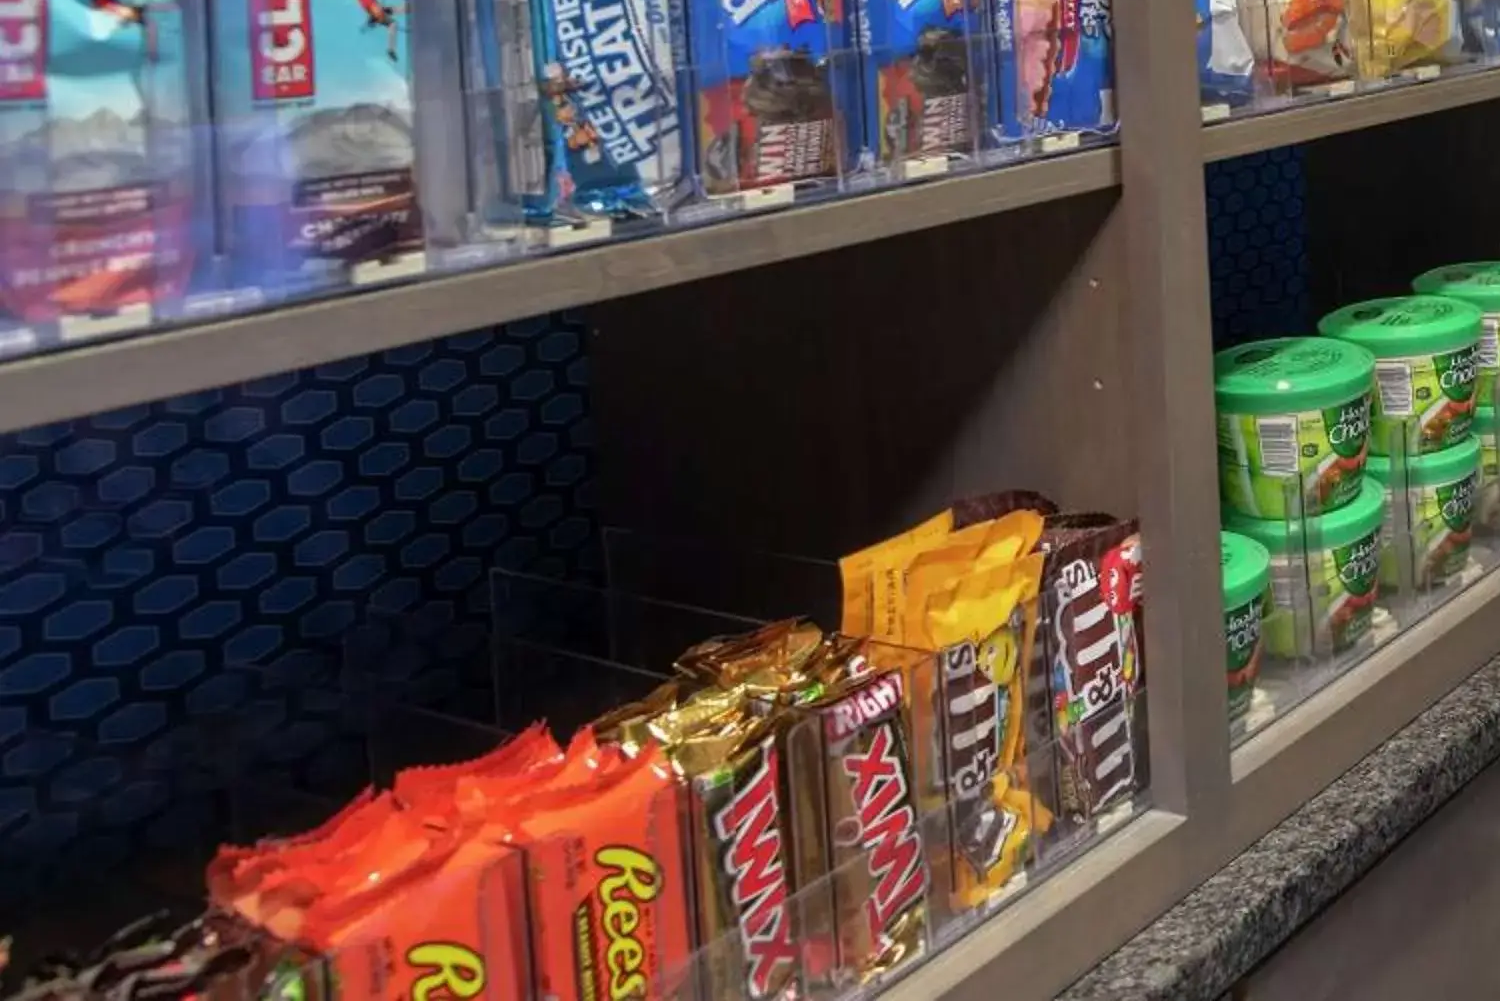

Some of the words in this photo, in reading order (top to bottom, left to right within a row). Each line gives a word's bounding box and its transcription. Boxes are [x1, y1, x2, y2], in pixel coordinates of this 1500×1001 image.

[586, 99, 637, 166] RICE
[758, 122, 786, 180] WIN
[714, 737, 799, 999] TWIX
